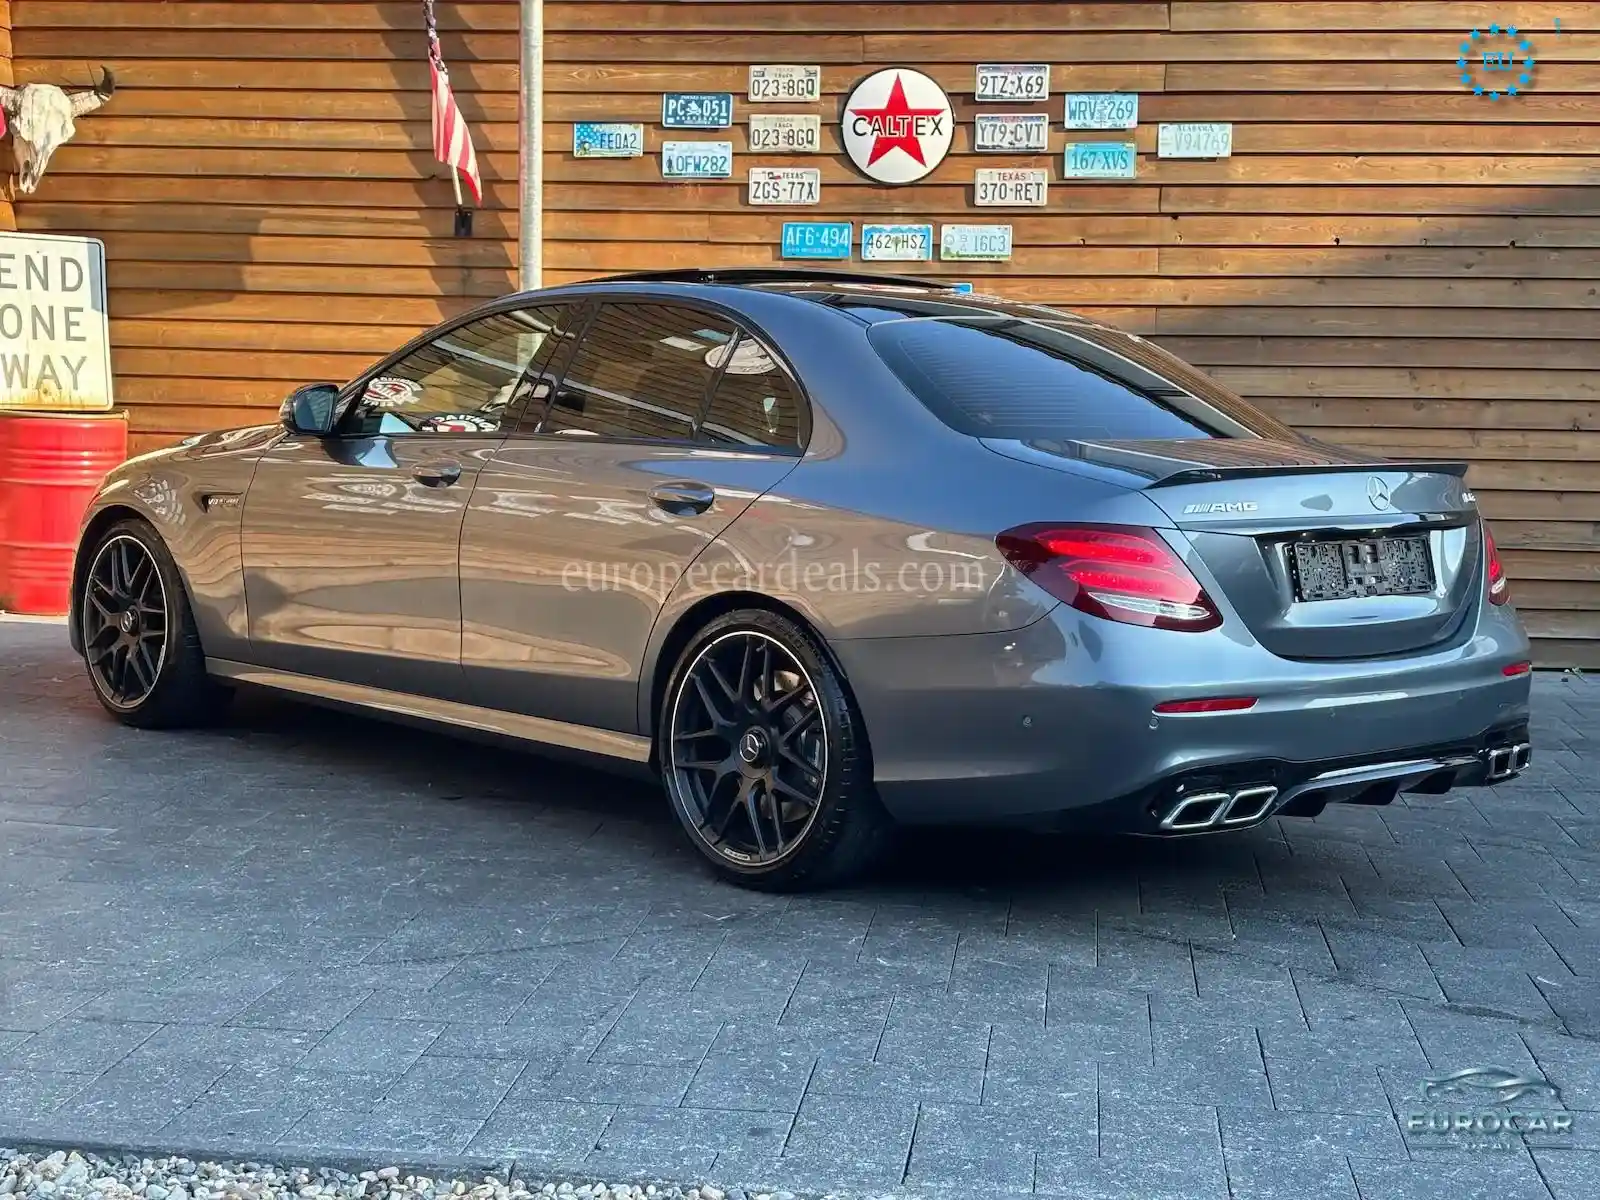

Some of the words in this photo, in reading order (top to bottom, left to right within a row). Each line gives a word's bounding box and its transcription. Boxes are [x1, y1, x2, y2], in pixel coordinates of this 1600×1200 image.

[668, 99, 686, 116] PC
[702, 99, 728, 117] 051
[1068, 100, 1098, 120] WRV
[1107, 100, 1134, 120] 269
[853, 115, 943, 138] CALTEX
[997, 172, 1026, 181] TEXAS
[867, 234, 892, 249] 462
[901, 234, 927, 249] HSZ
[0, 253, 84, 292] END
[0, 303, 87, 342] ONE
[0, 353, 88, 391] WAY
